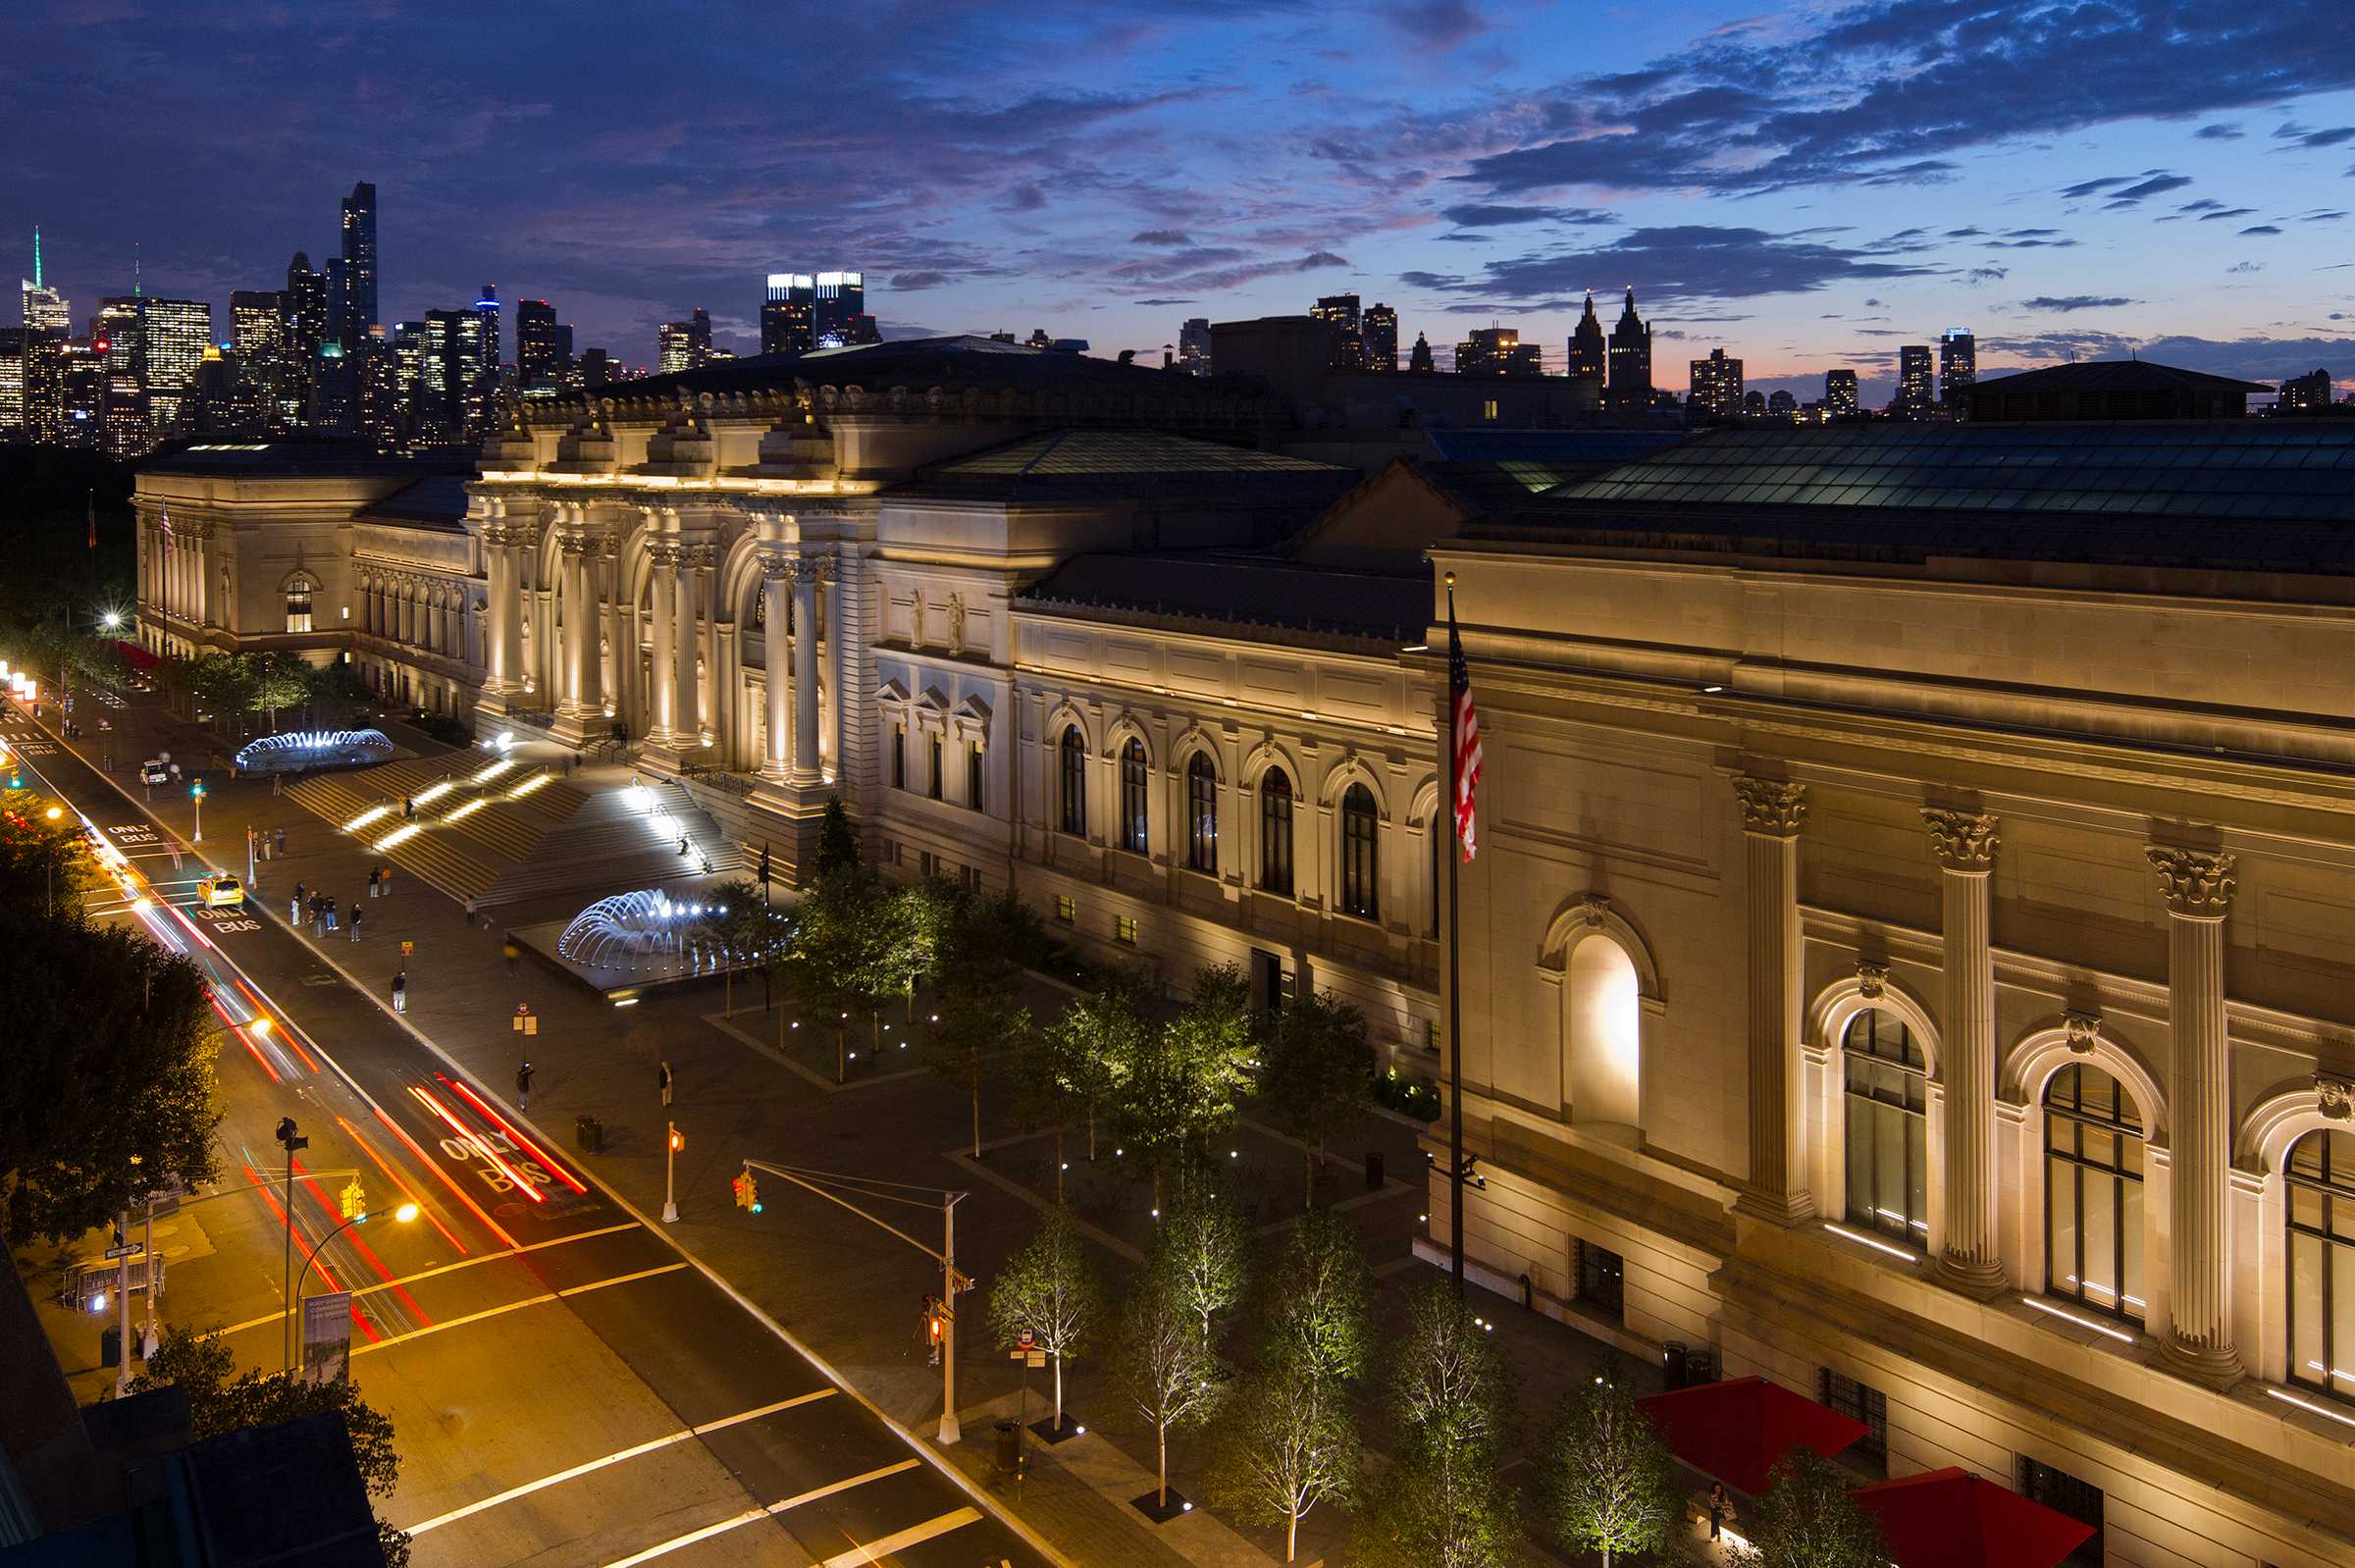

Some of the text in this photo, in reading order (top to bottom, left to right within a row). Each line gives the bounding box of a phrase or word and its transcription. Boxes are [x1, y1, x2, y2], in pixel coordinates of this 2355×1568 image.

[108, 824, 150, 834] ONLY
[119, 833, 159, 842] BUS
[196, 908, 248, 919] ONLY
[213, 919, 261, 933] BUS
